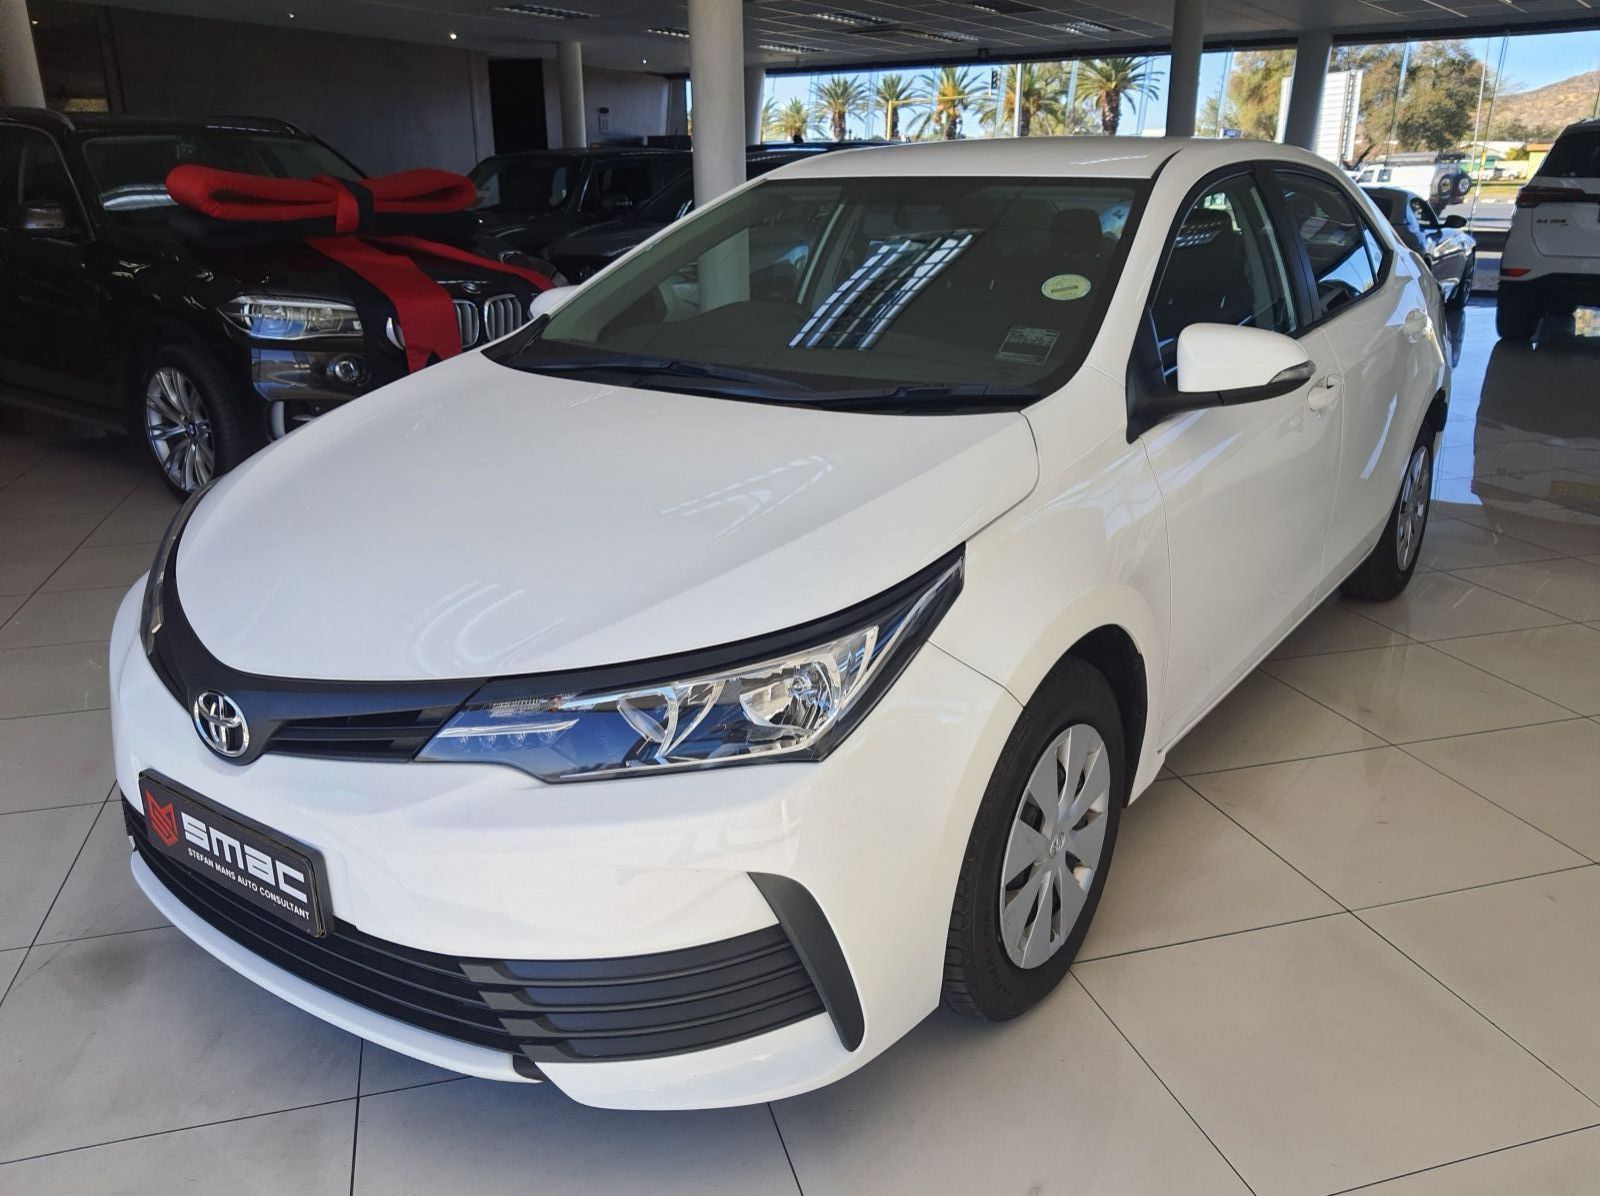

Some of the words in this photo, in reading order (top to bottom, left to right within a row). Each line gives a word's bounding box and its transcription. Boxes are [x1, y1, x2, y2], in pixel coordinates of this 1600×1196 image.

[188, 847, 214, 869] STEFAN
[215, 864, 236, 880] MANS
[237, 875, 258, 892] AUTO
[259, 886, 310, 920] CONSULTANT
